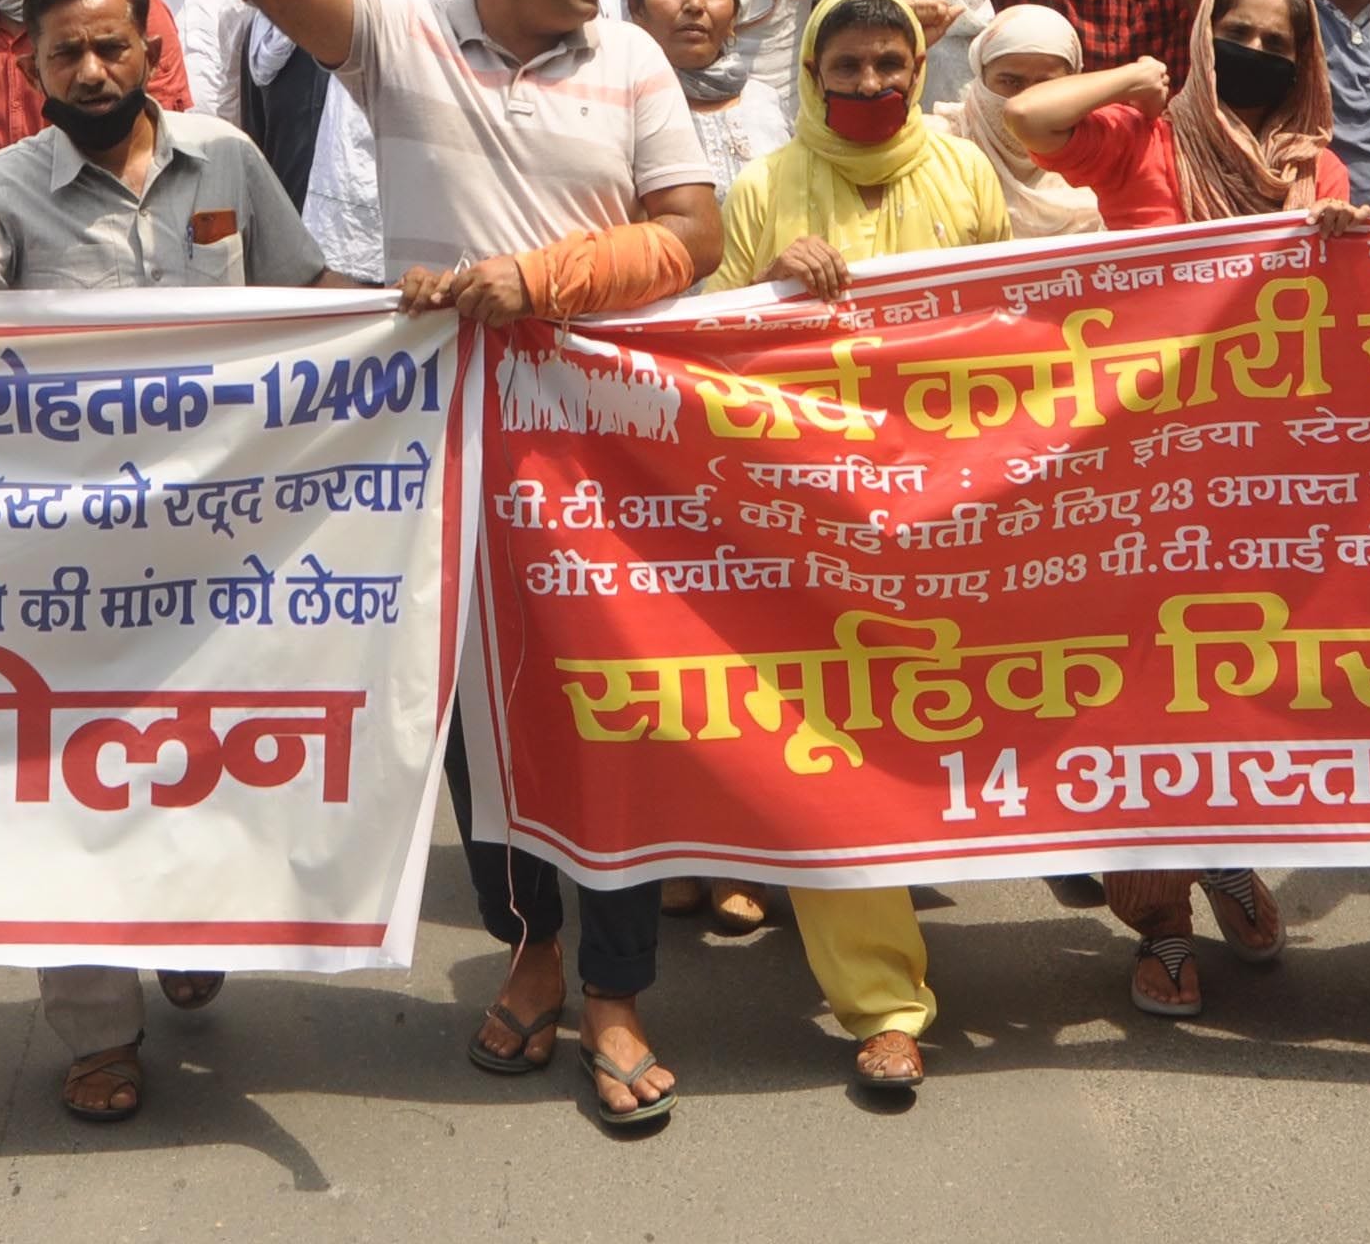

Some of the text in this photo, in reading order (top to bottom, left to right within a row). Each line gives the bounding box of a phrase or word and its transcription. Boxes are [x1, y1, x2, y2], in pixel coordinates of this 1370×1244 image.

[883, 290, 939, 326] करो
[1002, 267, 1084, 317] पुरानी
[1091, 261, 1165, 294] पैंशन
[1172, 250, 1253, 284] बहाल
[684, 335, 887, 442] सर्व
[897, 275, 1336, 441] कर्मचारी
[81, 461, 151, 529] को
[274, 440, 431, 513] करवाने
[742, 455, 929, 495] सम्बंधित
[1004, 444, 1108, 487] ऑल
[1130, 421, 1261, 468] इंडिया
[494, 480, 723, 532] पी.टी.आई.
[738, 499, 807, 535] की
[816, 511, 889, 554] नई
[896, 502, 998, 550] भर्ती
[997, 497, 1044, 537] के
[1052, 487, 1142, 528] लिए
[1150, 476, 1195, 514] 23
[1207, 472, 1359, 509] अगस्त
[19, 565, 91, 632] की
[100, 567, 198, 629] मांग
[207, 554, 275, 626] को
[285, 554, 403, 626] लेकर
[525, 549, 619, 598] और
[628, 545, 796, 597] बर्खास्त
[806, 553, 905, 612] किए
[915, 569, 990, 604] गए
[1001, 553, 1088, 593] 1983
[1099, 523, 1331, 578] पी.टी.आई
[554, 608, 1130, 776] सामूहिक
[939, 750, 1030, 822] 14
